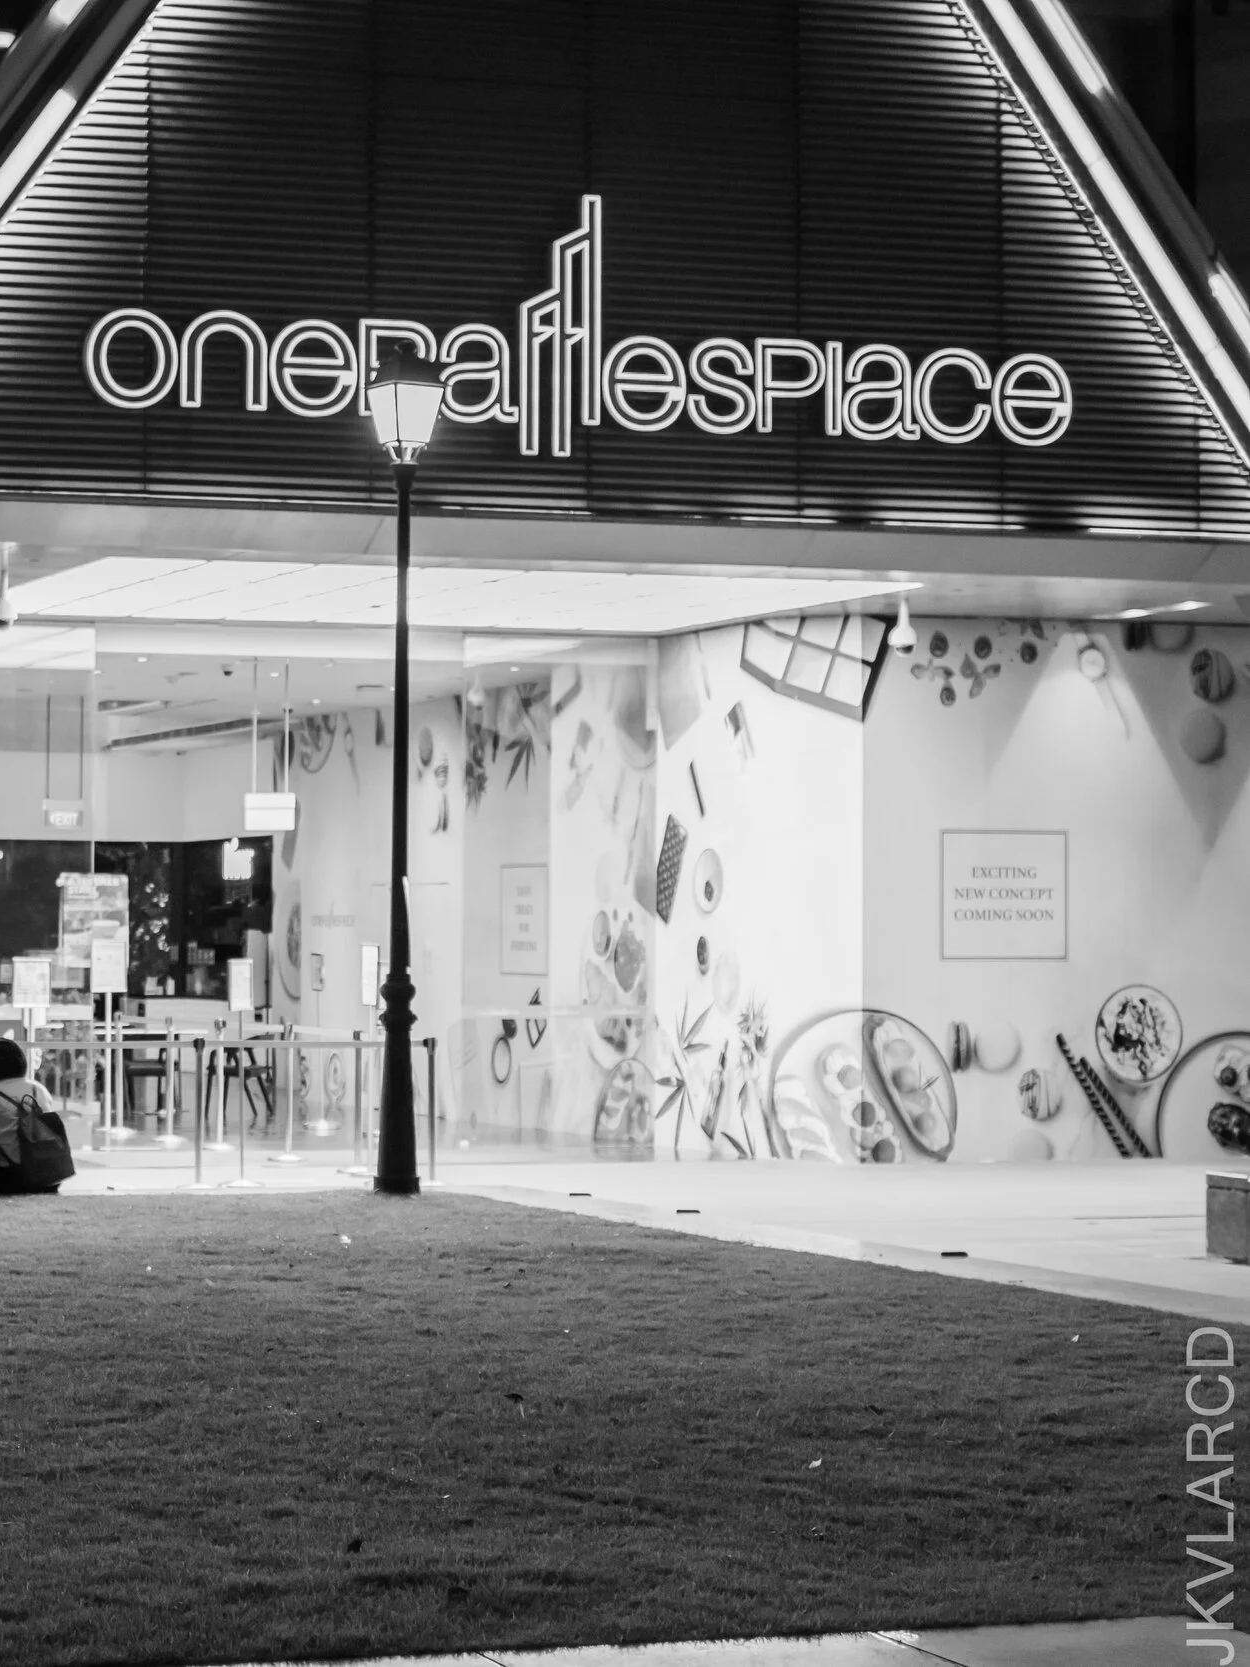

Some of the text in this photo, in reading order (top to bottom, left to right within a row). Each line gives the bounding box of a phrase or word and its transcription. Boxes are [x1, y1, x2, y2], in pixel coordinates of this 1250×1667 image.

[55, 813, 79, 827] EXIT
[971, 866, 1038, 879] EXCITING
[954, 887, 1055, 900] NEW CONCEPT
[953, 908, 1055, 921] COMING SOON
